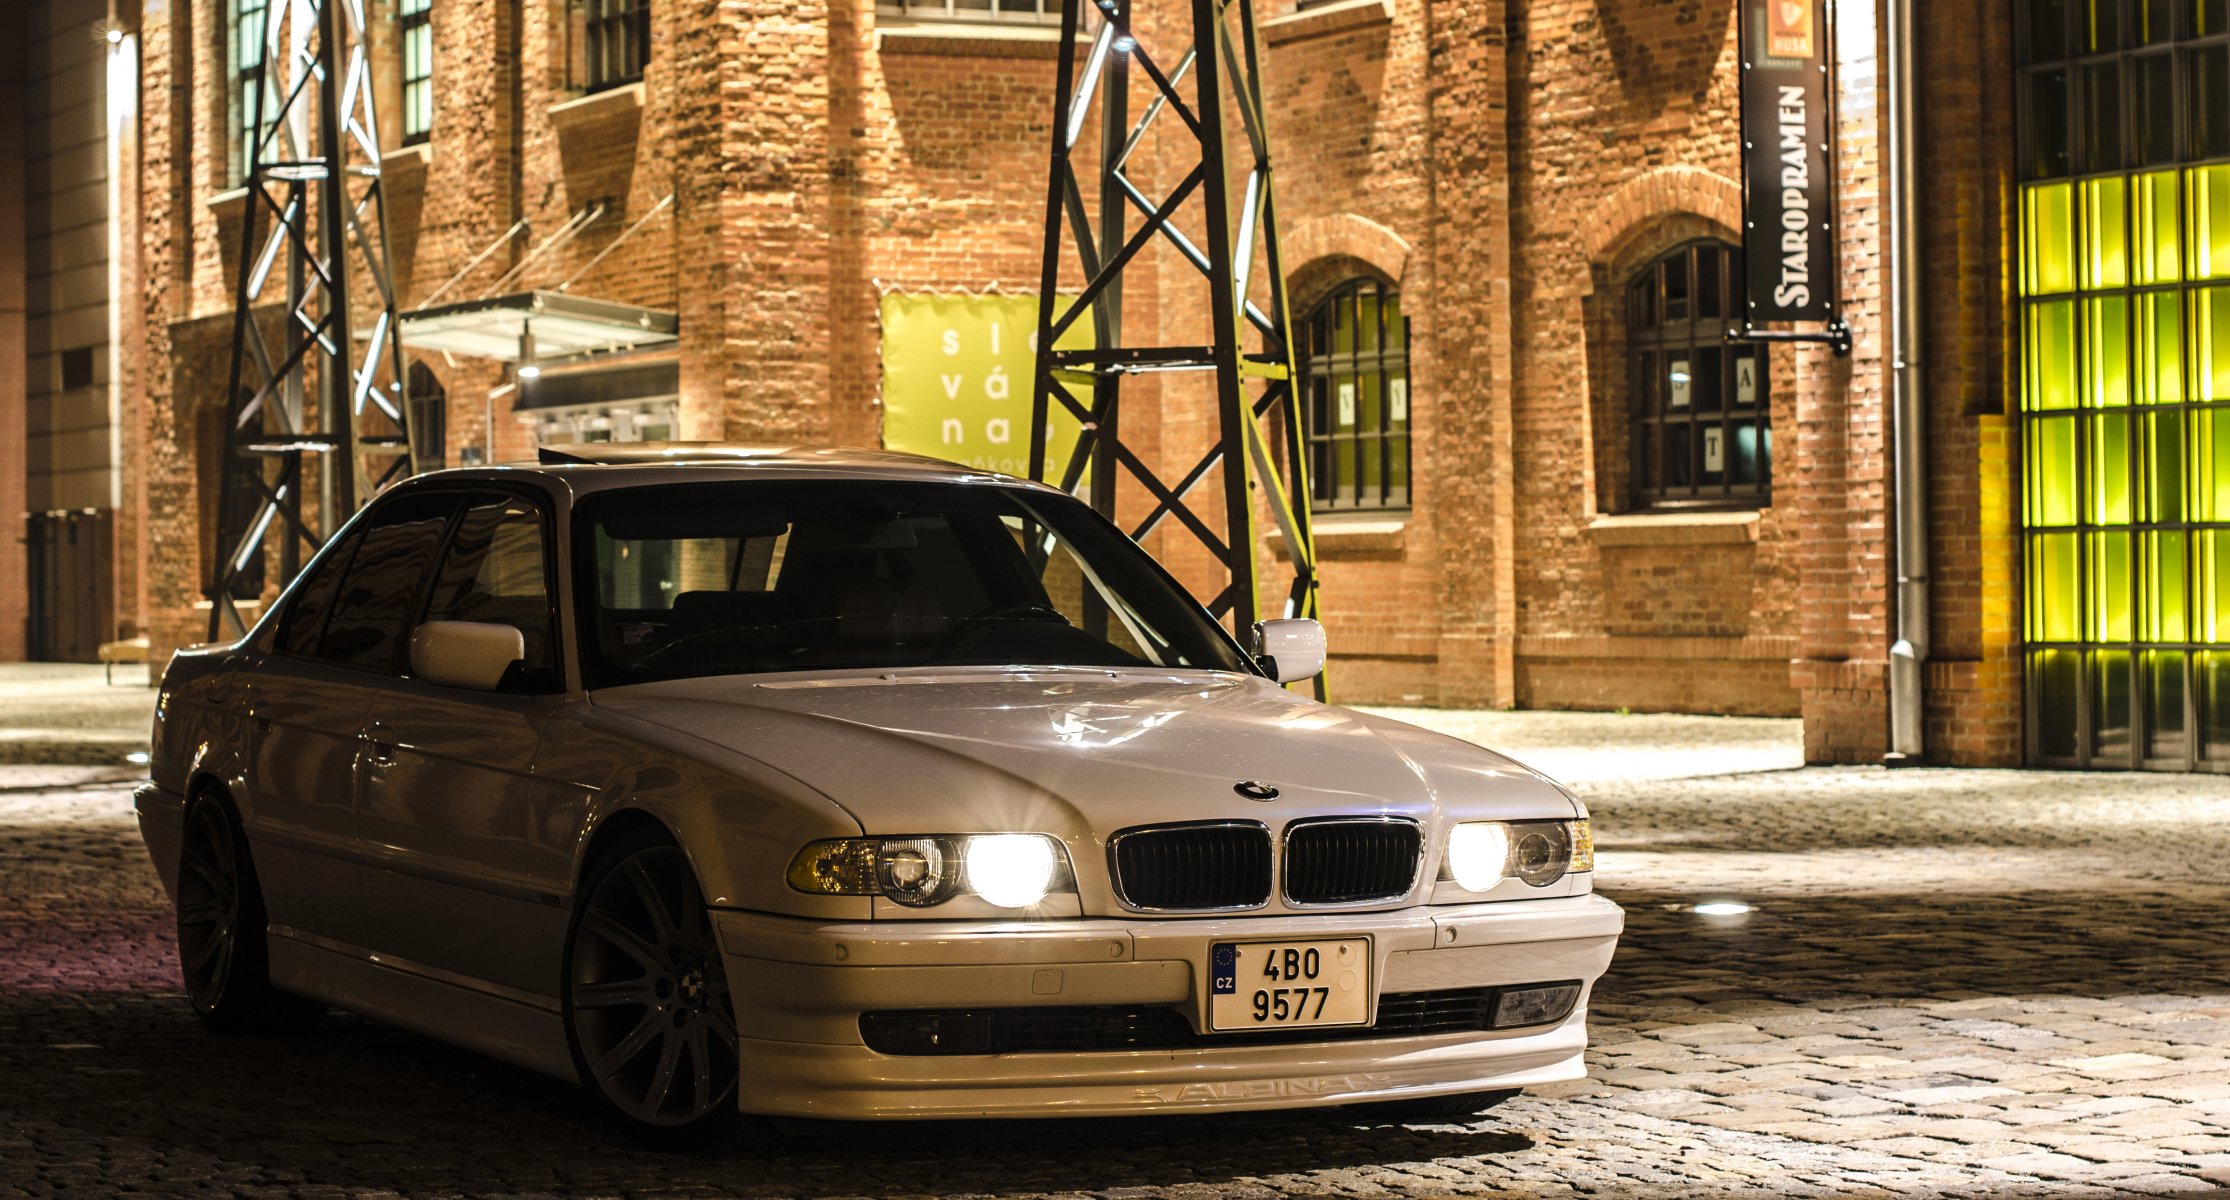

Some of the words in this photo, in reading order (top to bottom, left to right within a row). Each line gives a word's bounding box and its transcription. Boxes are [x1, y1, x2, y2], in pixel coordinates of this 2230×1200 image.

[1774, 86, 1810, 308] STAROPRAMEN
[1216, 977, 1233, 989] CZ
[1253, 987, 1329, 1022] 9577
